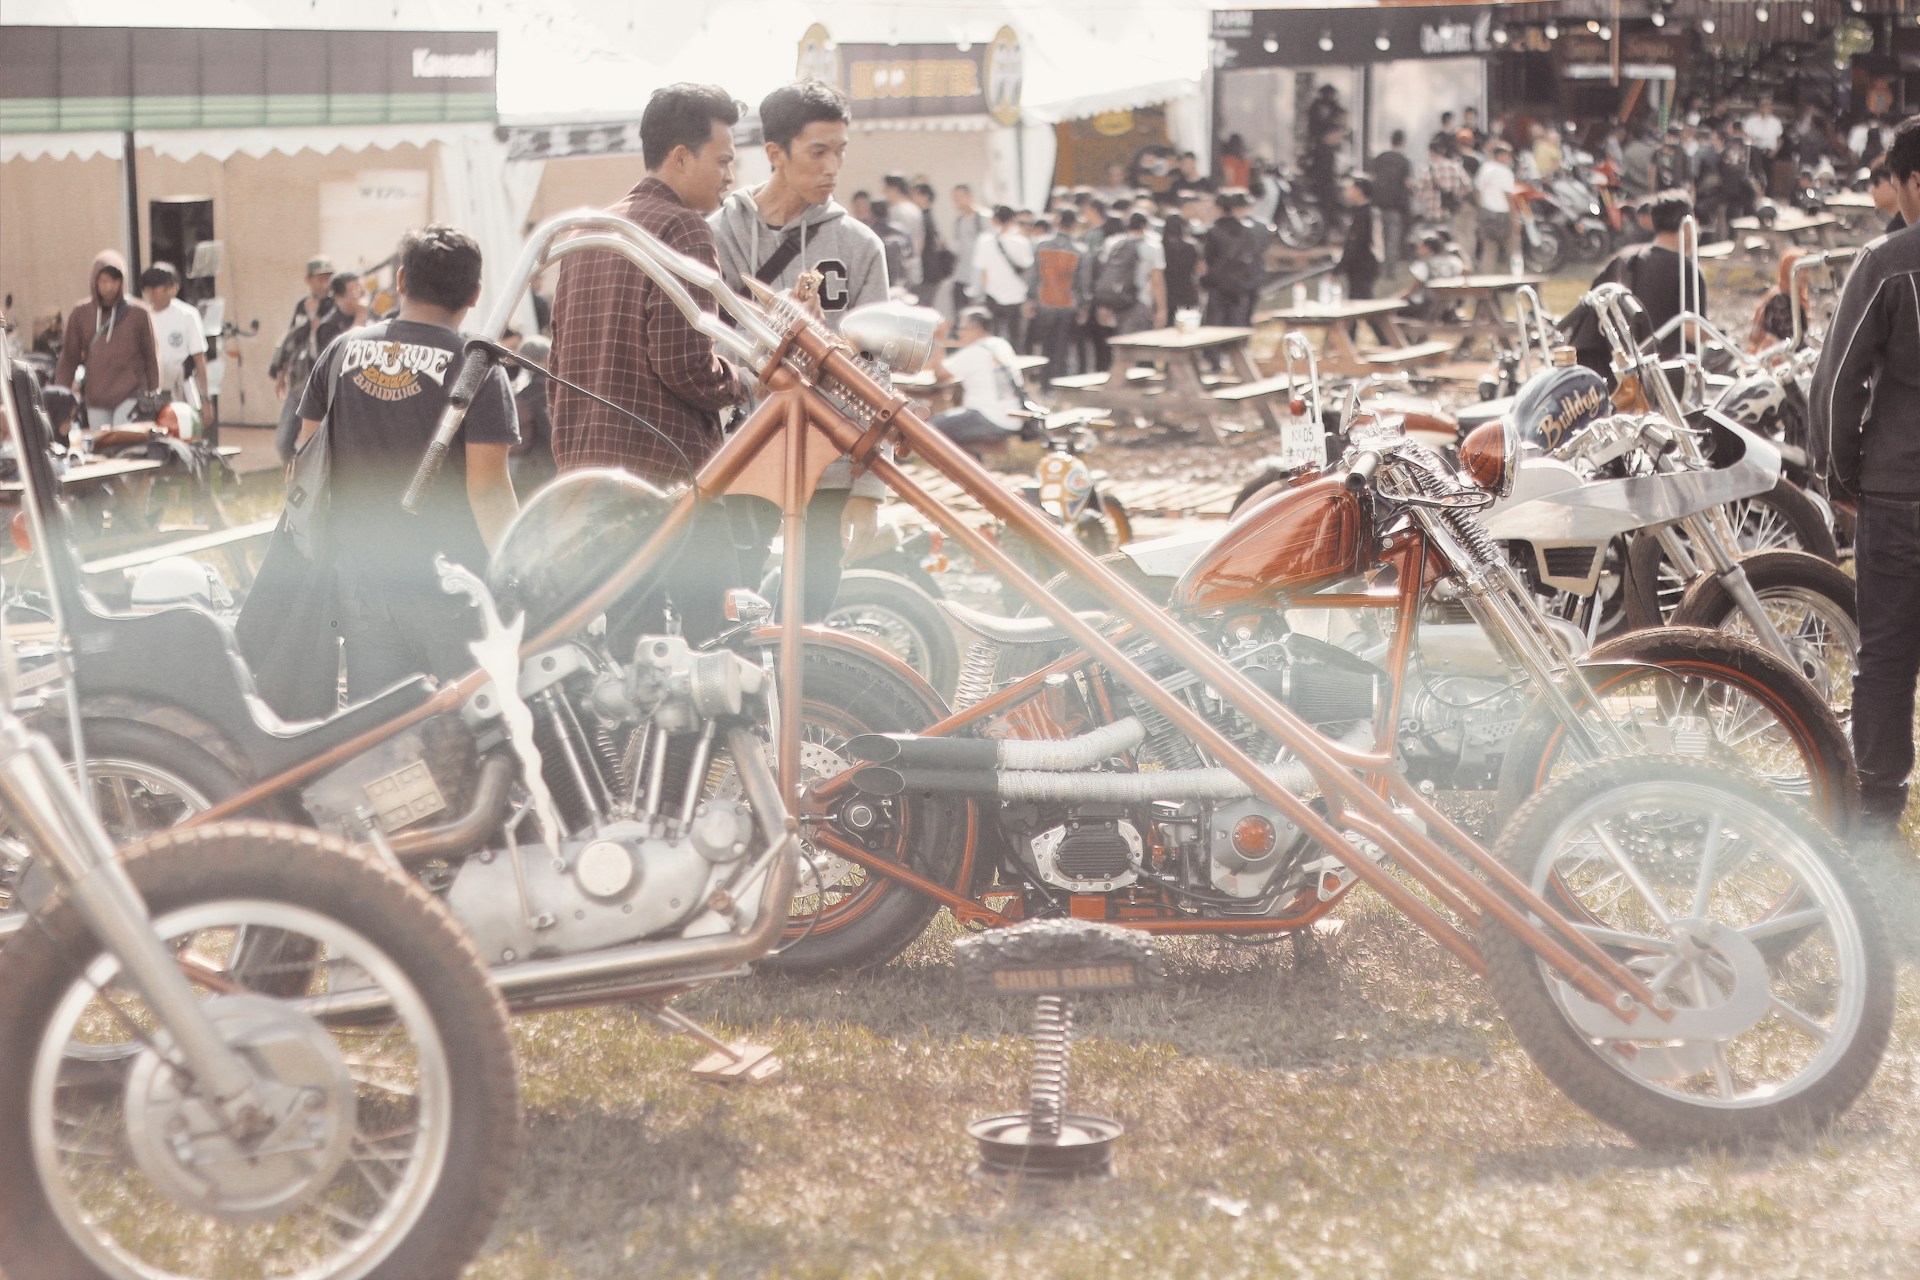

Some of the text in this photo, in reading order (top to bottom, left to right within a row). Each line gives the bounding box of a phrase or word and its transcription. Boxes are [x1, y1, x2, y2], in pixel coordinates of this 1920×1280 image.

[814, 259, 849, 312] C
[353, 373, 422, 401] BANDUNG
[1535, 385, 1600, 452] Bulldog
[1061, 966, 1135, 987] GARAGE
